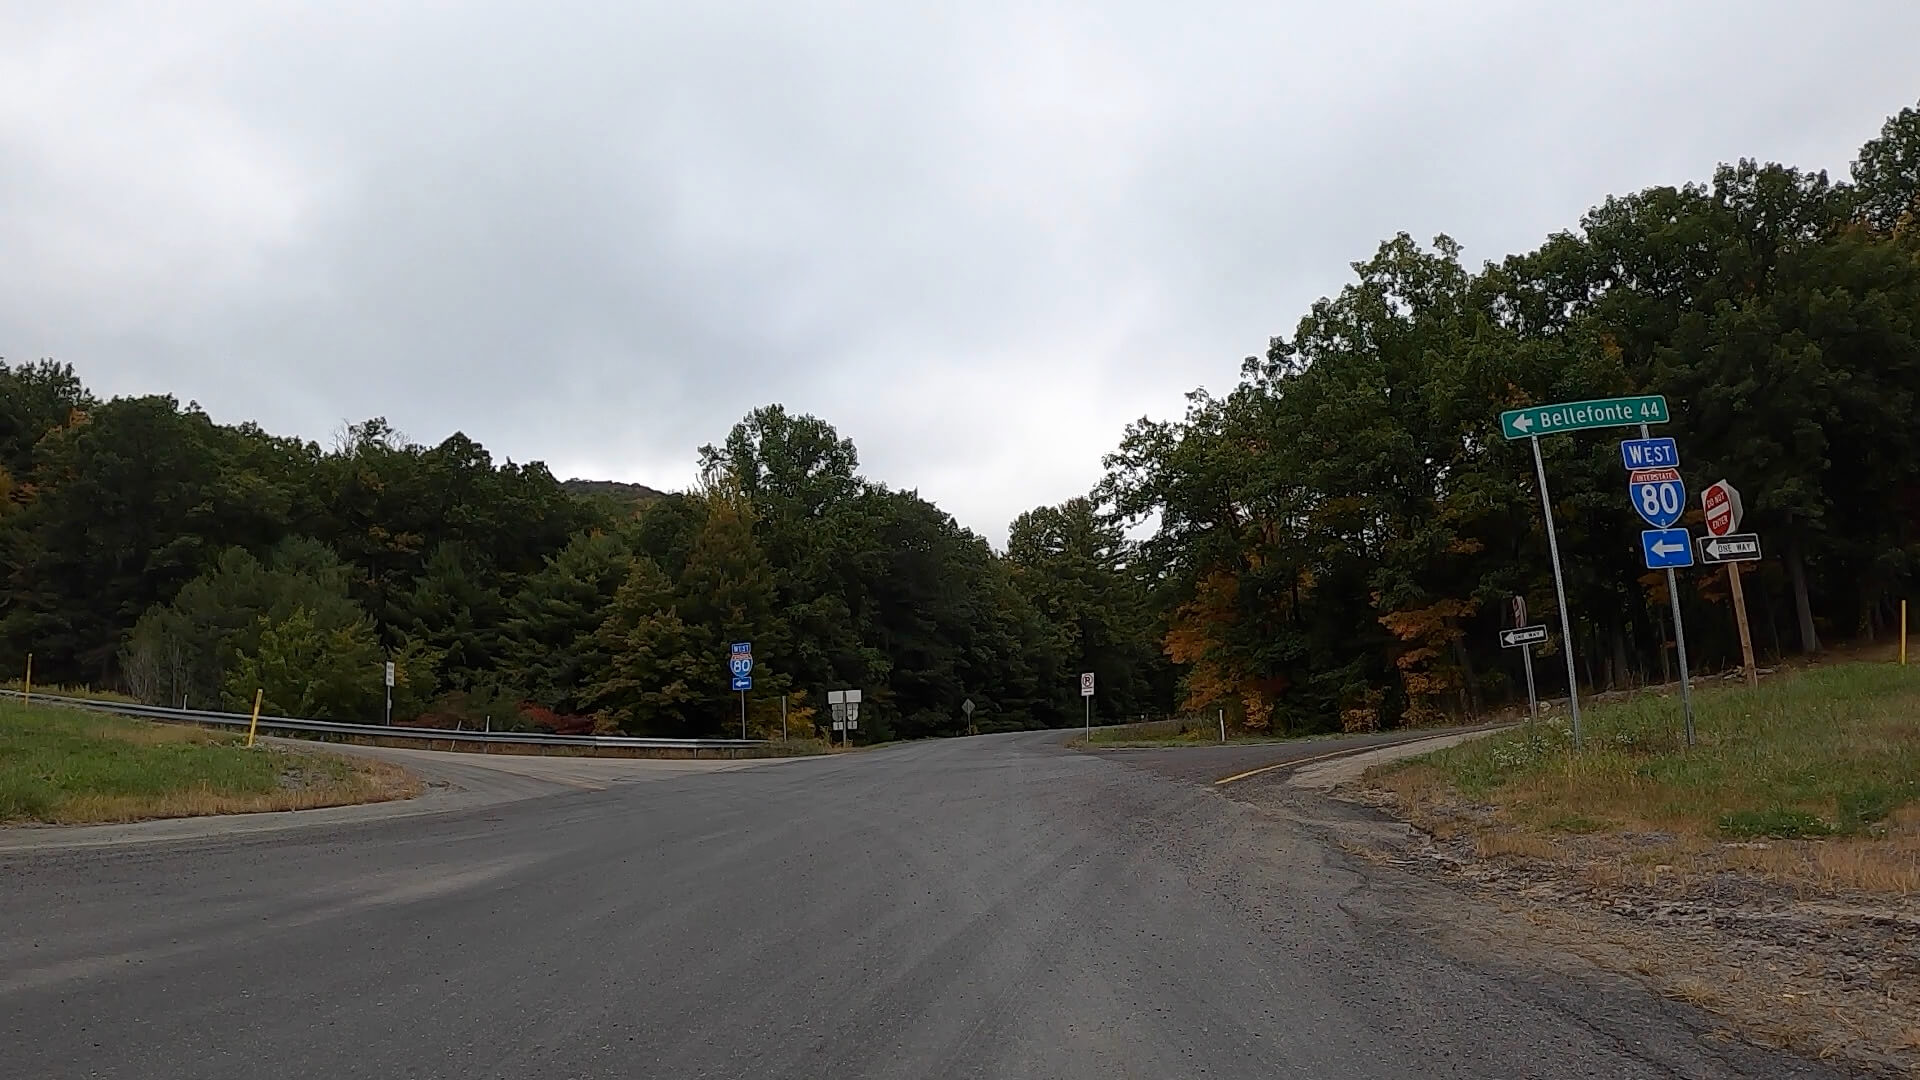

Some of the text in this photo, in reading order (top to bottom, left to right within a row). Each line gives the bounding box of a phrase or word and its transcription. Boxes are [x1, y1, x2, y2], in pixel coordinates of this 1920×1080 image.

[1540, 402, 1660, 428] Bellefonte 44
[1628, 445, 1671, 464] WEST
[1636, 472, 1673, 482] INTERSTATE
[1641, 483, 1678, 516] 80
[1706, 491, 1725, 509] DO NOT
[1712, 515, 1728, 530] ENTER
[1717, 543, 1752, 553] ONE WAY
[734, 660, 750, 672] 80
